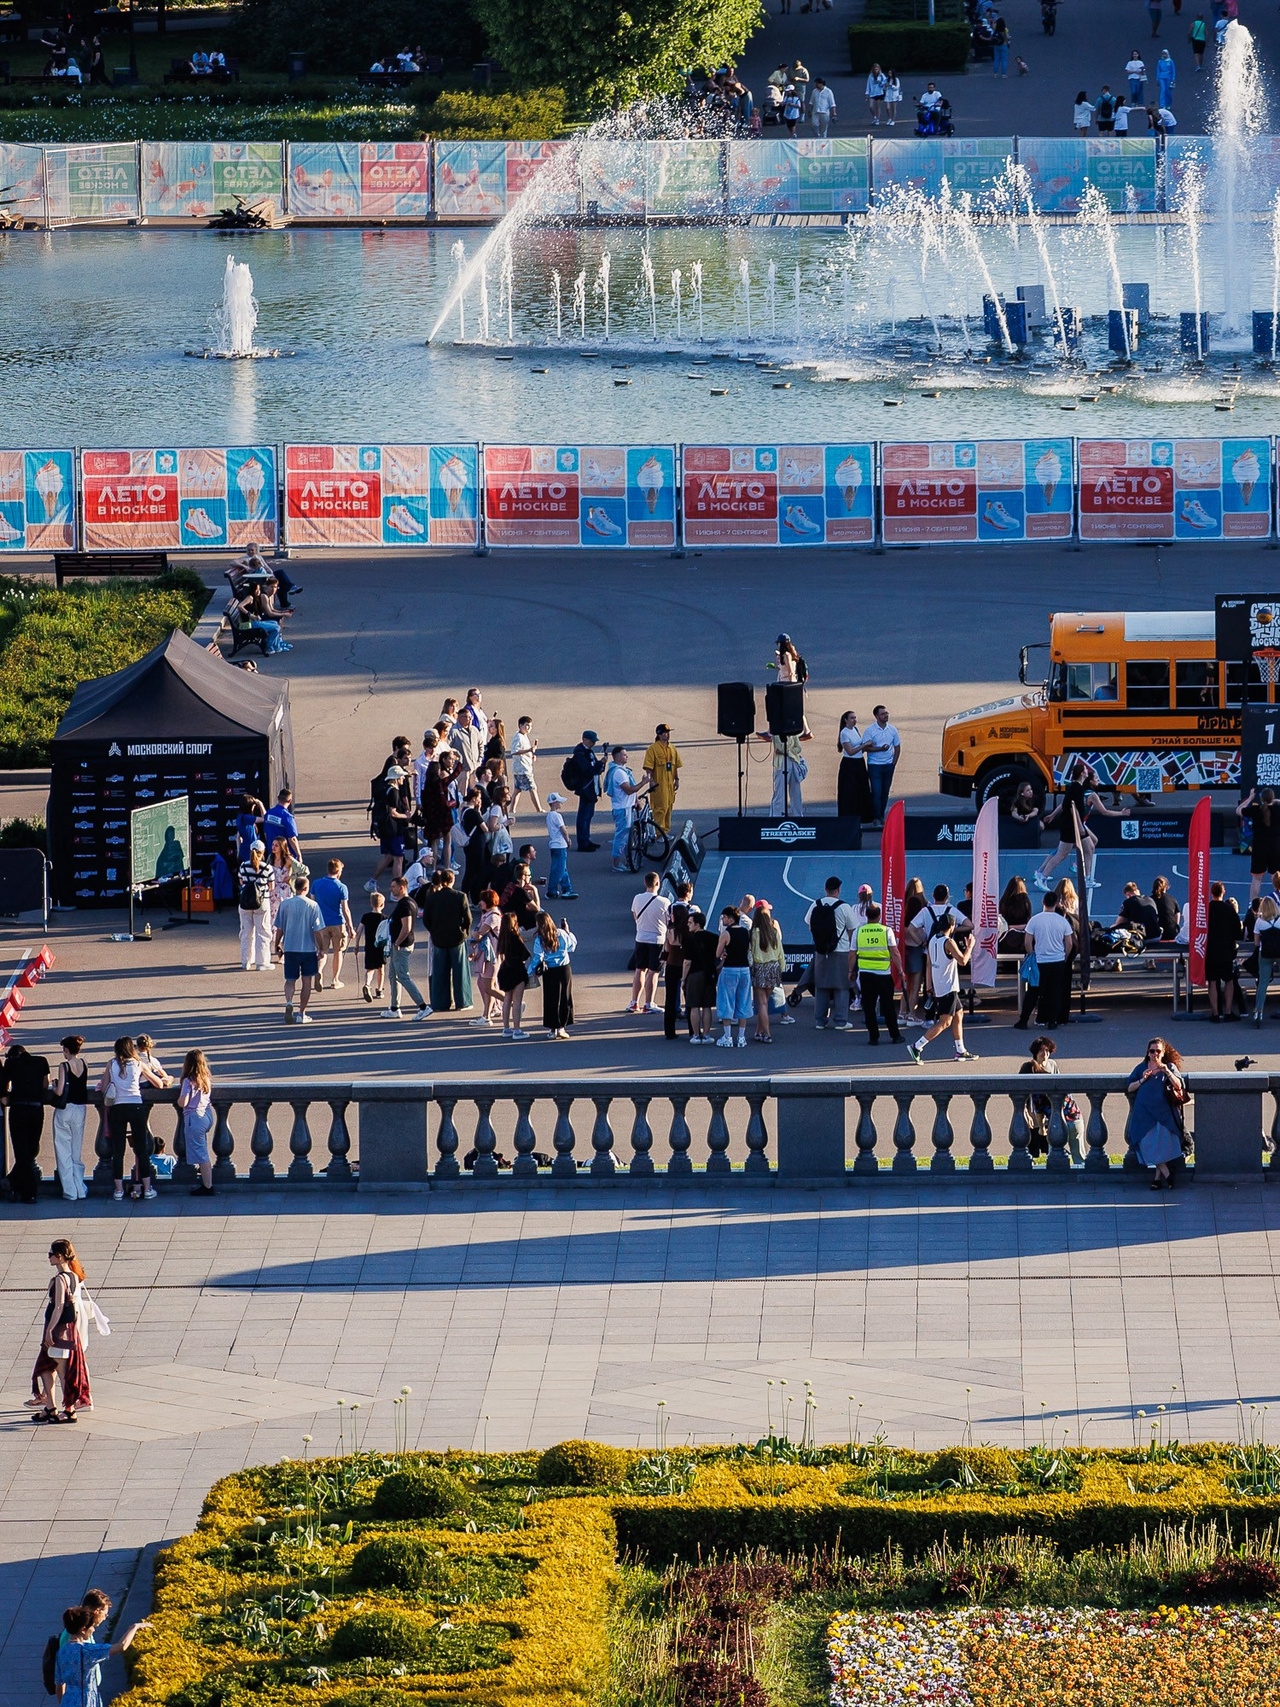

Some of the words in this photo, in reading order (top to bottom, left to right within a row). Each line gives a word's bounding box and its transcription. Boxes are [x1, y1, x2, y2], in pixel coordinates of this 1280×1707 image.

[302, 480, 368, 498] ЛЕТО
[500, 482, 566, 500] ЛЕТО
[698, 482, 765, 499] ЛЕТО
[897, 478, 965, 496] ЛЕТО
[1094, 476, 1161, 494] ЛЕТО
[98, 484, 166, 502] ЛЕТО
[300, 501, 310, 510] В
[314, 501, 368, 510] МОСКВЕ
[500, 502, 508, 511] В
[512, 502, 566, 511] МОСКВЕ
[697, 502, 706, 510] В
[710, 502, 765, 510] МОСКВЕ
[897, 499, 906, 508] В
[910, 498, 965, 508] МОСКВЕ
[1094, 496, 1102, 504] В
[1107, 496, 1162, 506] МОСКВЕ
[98, 506, 106, 514] В
[110, 504, 166, 514] МОСКВЕ
[1151, 736, 1182, 745] УЗНАЙ
[1183, 736, 1221, 744] БОЛЬШЕ
[1223, 736, 1236, 744] НА
[1264, 724, 1275, 745] 1
[127, 741, 184, 756] МОСКОВСКИЙ
[186, 744, 212, 755] СПОРТ
[1142, 820, 1178, 828] Департамент
